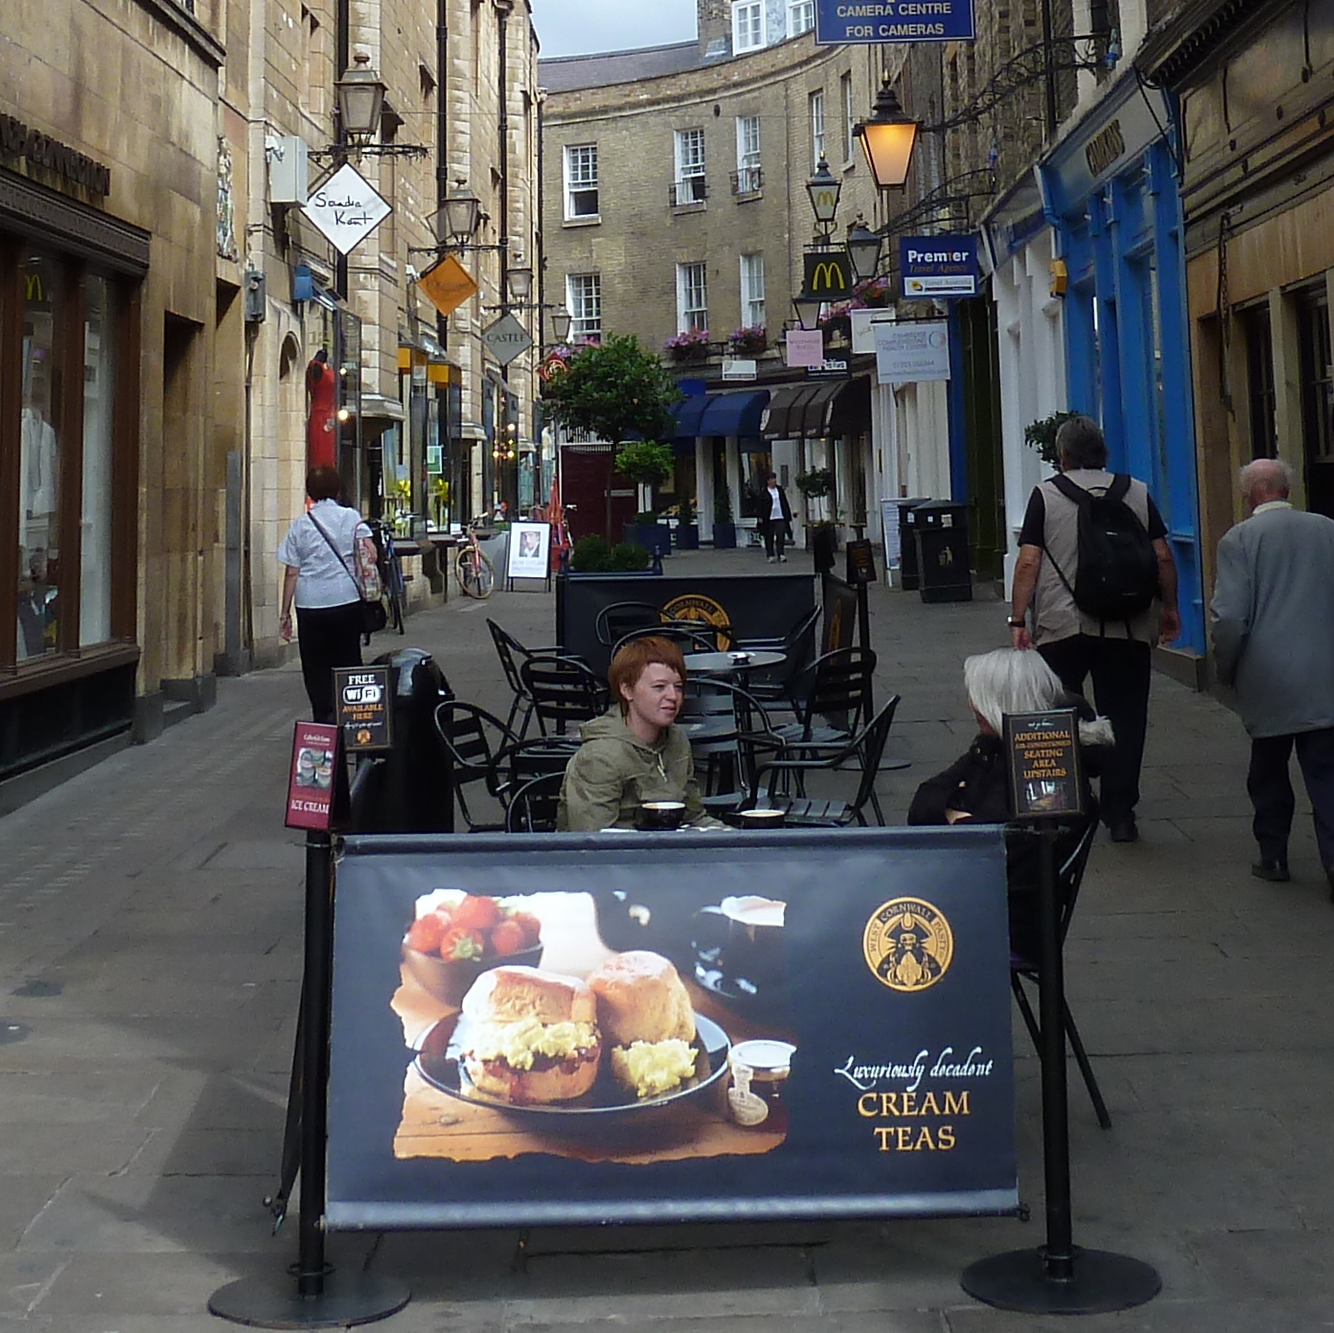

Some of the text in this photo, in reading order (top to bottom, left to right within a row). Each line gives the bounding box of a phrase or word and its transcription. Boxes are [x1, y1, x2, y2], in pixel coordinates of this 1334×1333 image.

[837, 2, 952, 17] CAMERA CENTRE
[846, 23, 944, 37] FOR CAMERAS
[907, 248, 970, 263] Premier
[486, 333, 526, 345] CASTLE
[348, 674, 375, 684] FREE
[342, 704, 383, 714] AVAILABLE
[1014, 730, 1071, 742] ADDITIONAL
[1024, 748, 1064, 759] SEATING
[1032, 758, 1057, 769] AREA
[1023, 767, 1068, 779] UPSTAIRS
[291, 798, 330, 815] ICE CREAM
[880, 902, 933, 922] CORNWALL
[834, 1046, 994, 1092] Luxuriously decadent
[857, 1090, 971, 1117] CREAM
[873, 1125, 957, 1152] TEAS
